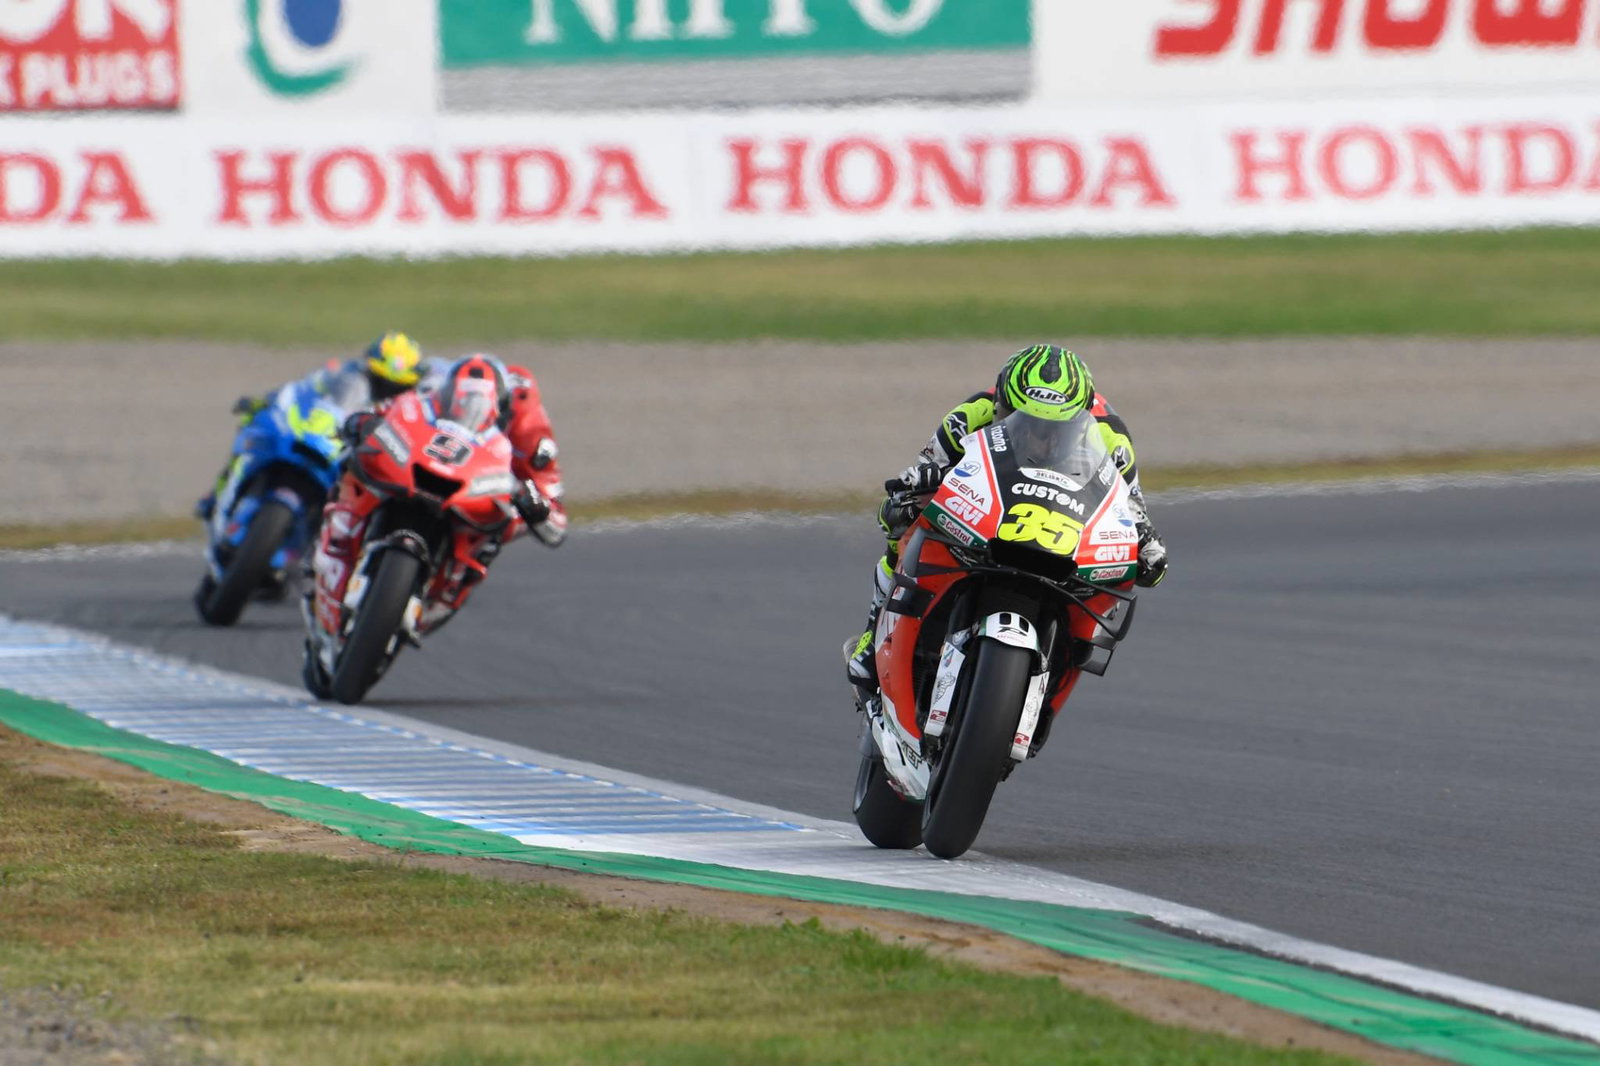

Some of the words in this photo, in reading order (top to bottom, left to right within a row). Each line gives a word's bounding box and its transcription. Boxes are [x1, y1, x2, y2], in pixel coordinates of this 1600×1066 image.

[23, 52, 174, 106] PLUGS
[213, 146, 667, 227] HONDA
[727, 135, 1174, 213] HONDA
[1028, 389, 1064, 402] HJC
[425, 433, 473, 466] 9
[948, 477, 985, 506] SENA
[1011, 482, 1085, 516] CUSTOM
[945, 496, 985, 526] GIVI
[945, 521, 972, 545] Castrol
[998, 503, 1084, 556] 35
[1098, 530, 1137, 541] SENA
[1094, 545, 1130, 562] GIVI
